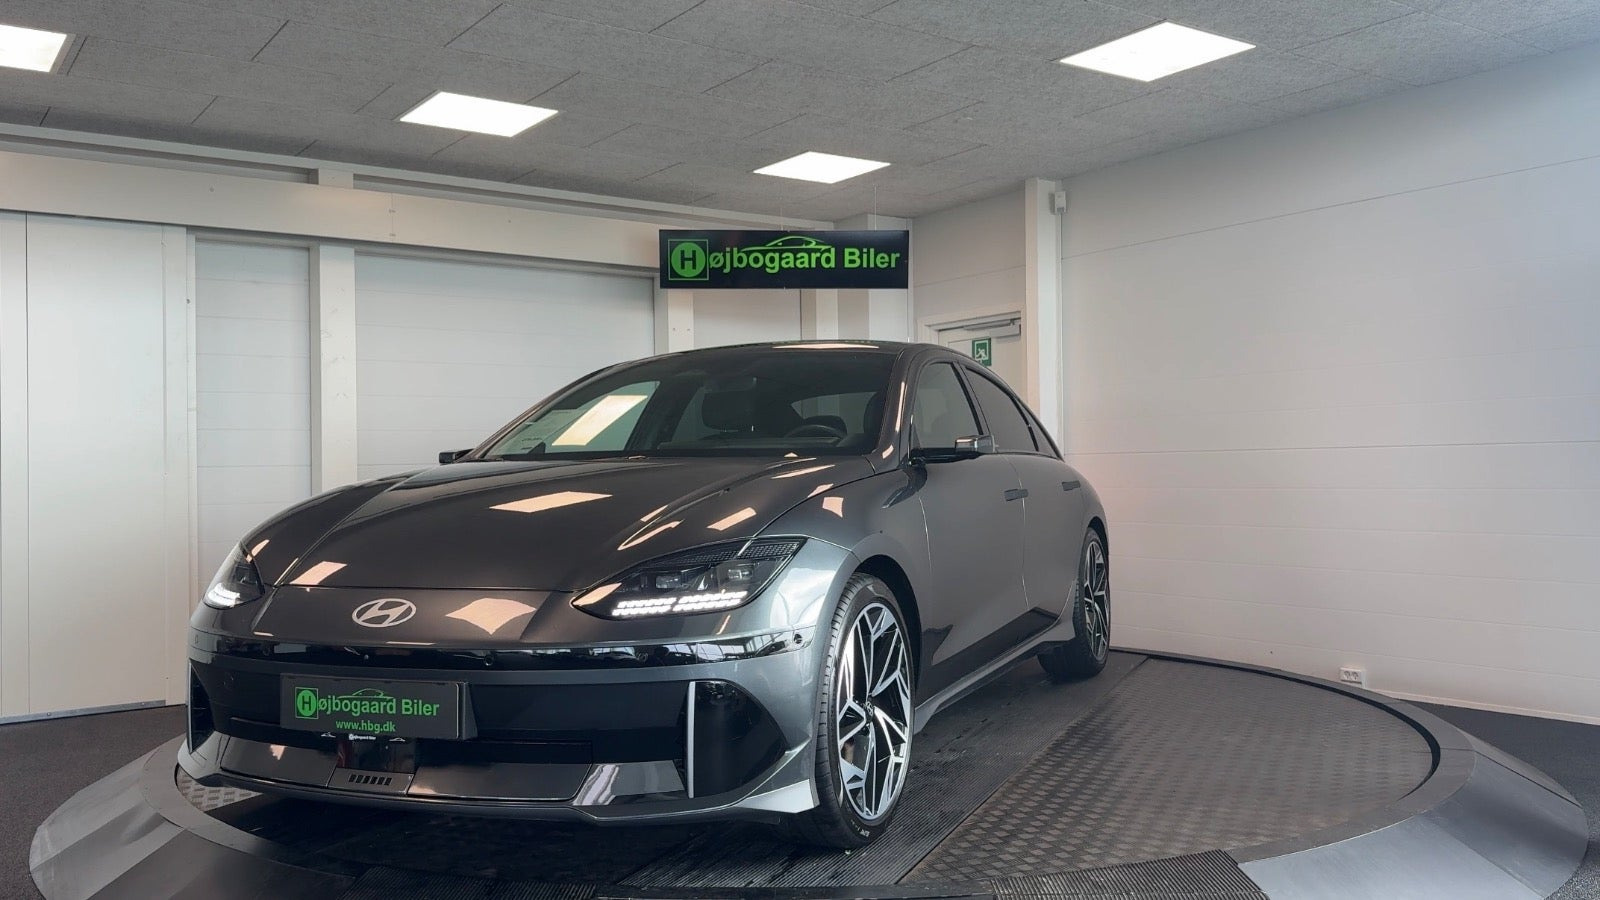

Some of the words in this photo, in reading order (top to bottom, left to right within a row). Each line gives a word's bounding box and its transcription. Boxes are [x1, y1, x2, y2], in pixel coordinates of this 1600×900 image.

[672, 243, 836, 277] Højbogaard
[844, 248, 900, 269] Biler
[297, 690, 397, 717] Højbogaard
[401, 699, 440, 716] Biler
[335, 719, 396, 734] www.hbg.dk
